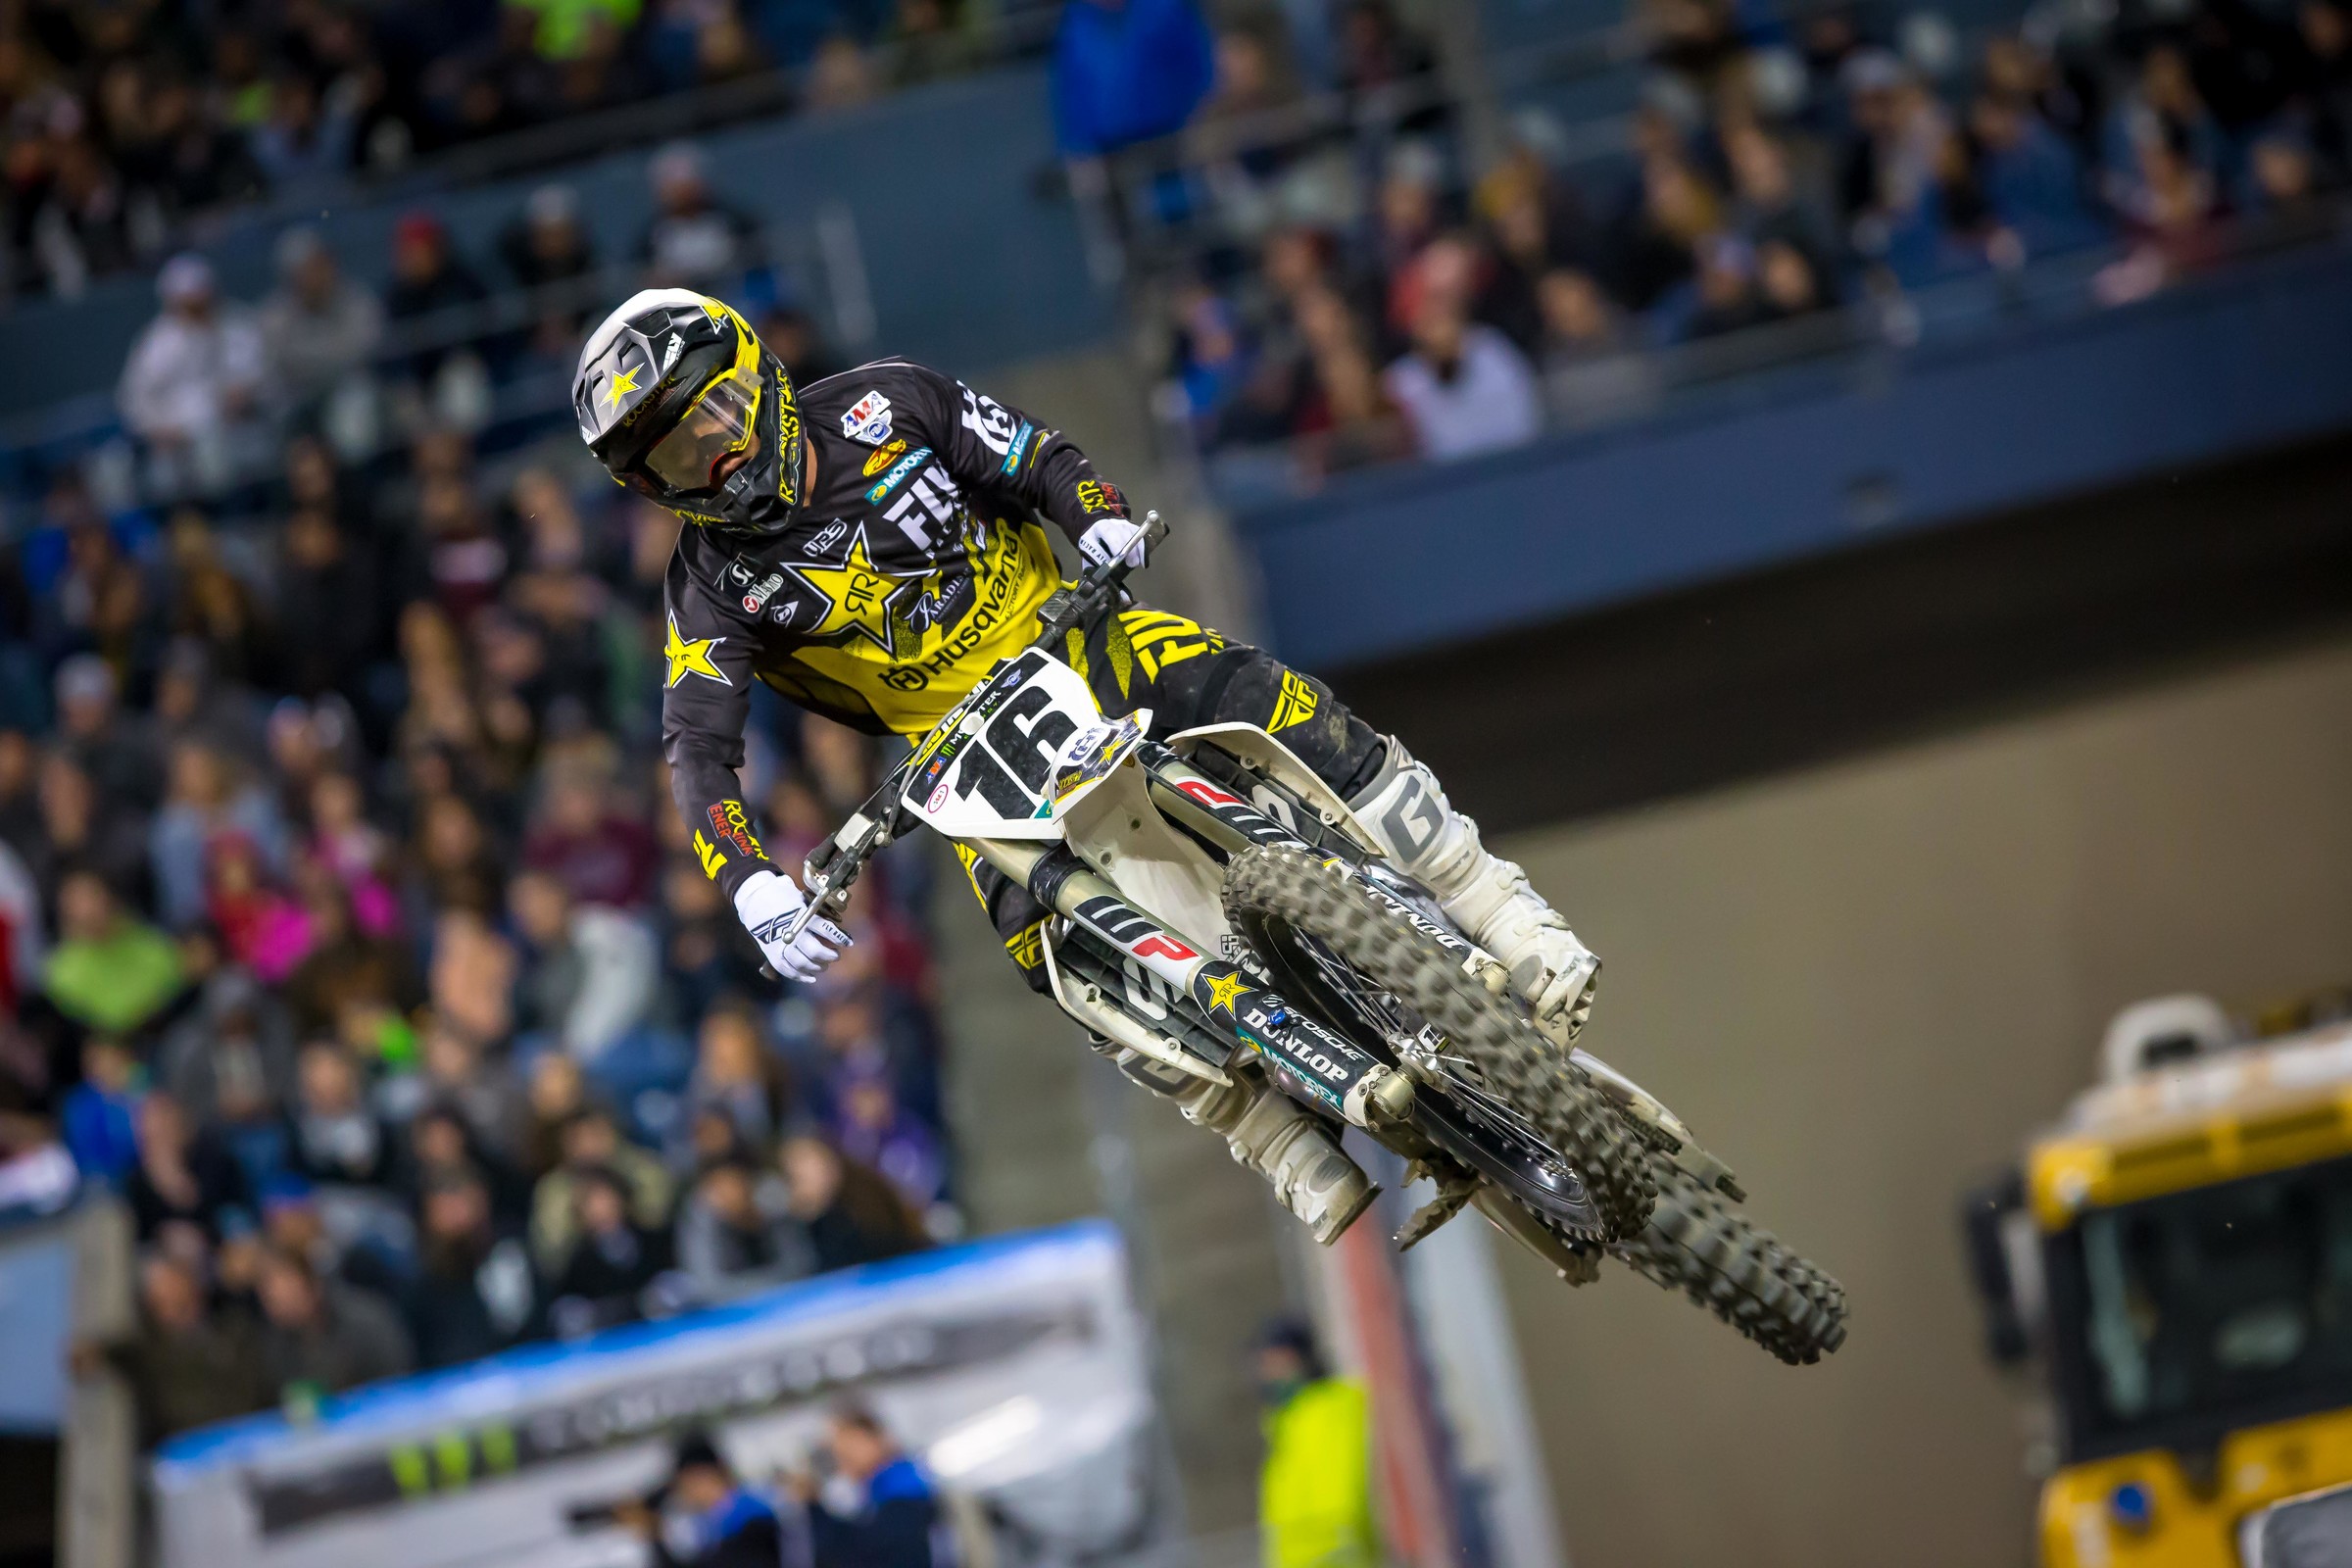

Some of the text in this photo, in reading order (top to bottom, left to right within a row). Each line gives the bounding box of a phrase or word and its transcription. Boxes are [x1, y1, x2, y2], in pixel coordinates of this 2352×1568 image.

[884, 447, 932, 487] MOTO
[921, 535, 1020, 676] Husqvarna
[950, 689, 1002, 745] MTER
[955, 685, 1079, 820] 16
[1243, 1008, 1349, 1081] DUNLOP
